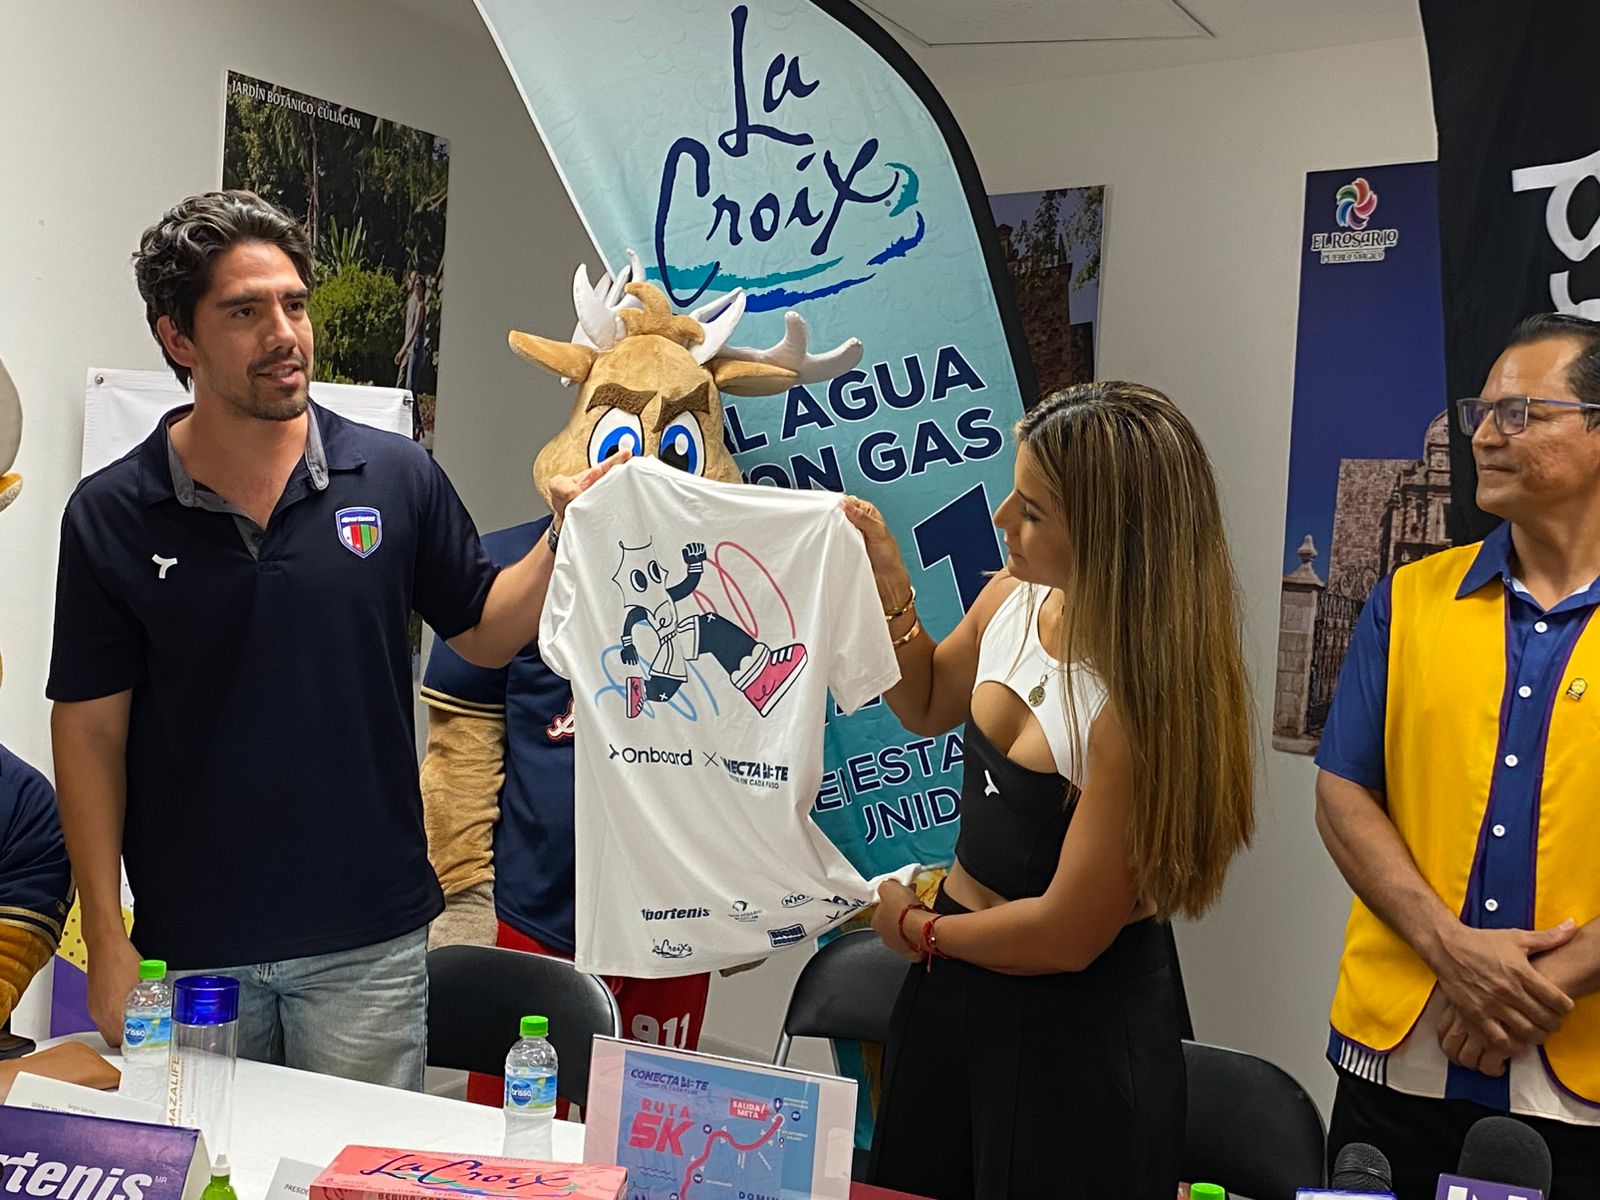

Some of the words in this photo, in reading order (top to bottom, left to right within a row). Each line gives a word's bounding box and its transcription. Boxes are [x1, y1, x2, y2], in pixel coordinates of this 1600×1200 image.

[717, 4, 821, 158] La
[231, 80, 266, 101] JARDÍN
[266, 91, 317, 117] BOTÁNICO,
[317, 104, 362, 130] CULIACÁN
[654, 136, 900, 308] Croix
[1312, 233, 1330, 251] EL
[723, 404, 769, 455] L
[780, 344, 988, 441] AGUA
[742, 445, 846, 493] ON
[855, 407, 1004, 484] GAS
[621, 746, 693, 767] Onboard
[631, 1012, 691, 1050] 911
[641, 1097, 692, 1120] RUTA
[629, 1111, 696, 1156] 5K
[359, 1153, 426, 1180] La
